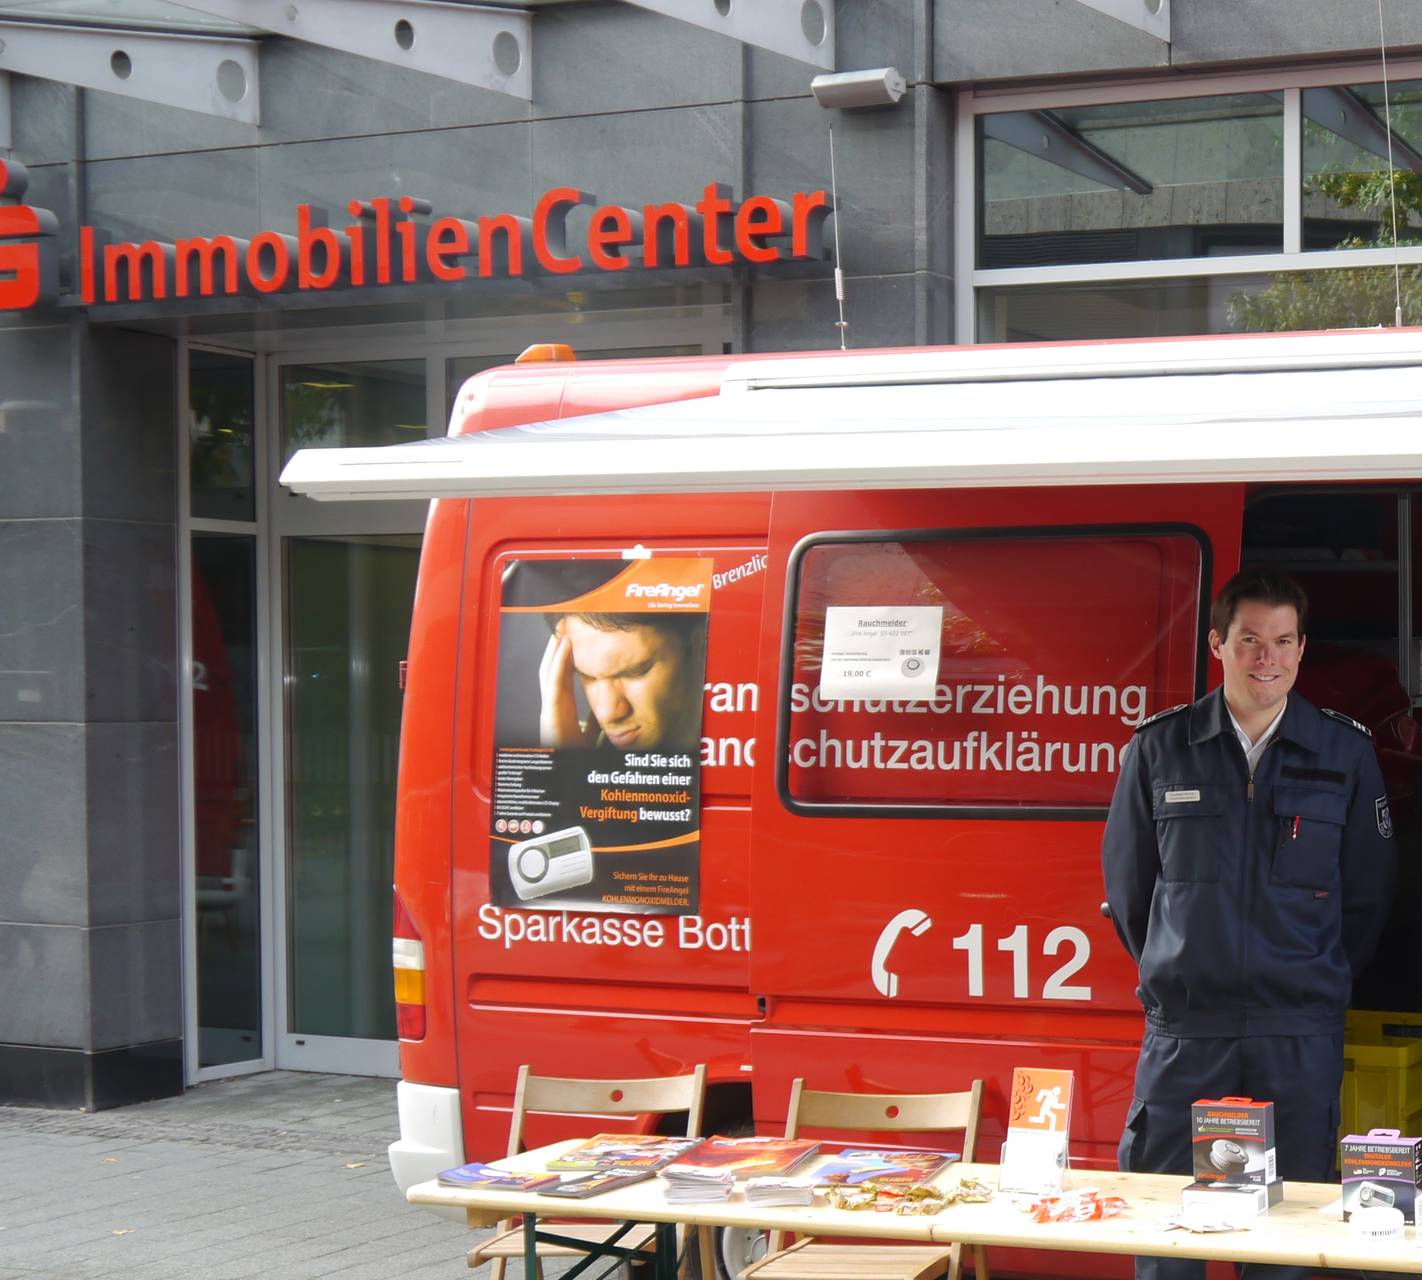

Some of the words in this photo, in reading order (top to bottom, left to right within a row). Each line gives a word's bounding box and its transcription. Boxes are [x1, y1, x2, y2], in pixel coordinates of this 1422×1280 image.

[81, 182, 826, 304] ImmobilienCenter
[625, 583, 702, 601] FireAngel
[858, 619, 907, 628] Rauchmelder
[789, 730, 1131, 773] chutzaufklärun
[624, 753, 649, 767] Sind
[650, 754, 668, 768] Sie
[668, 755, 691, 768] sich
[587, 770, 609, 784] den
[610, 771, 660, 785] Gefahren
[661, 772, 691, 785] einer
[601, 788, 691, 803] Kohlenmonoxid-
[579, 806, 638, 822] Vergiftung
[639, 807, 690, 822] bewusst?
[612, 872, 637, 880] Sichern
[638, 872, 648, 881] Sie
[668, 874, 689, 883] Hause
[624, 884, 636, 892] mit
[636, 885, 657, 893] einem
[657, 885, 689, 895] FireAngel
[478, 903, 664, 948] Sparkasse
[952, 924, 1092, 1000] 112
[1349, 1145, 1367, 1153] JAHRE
